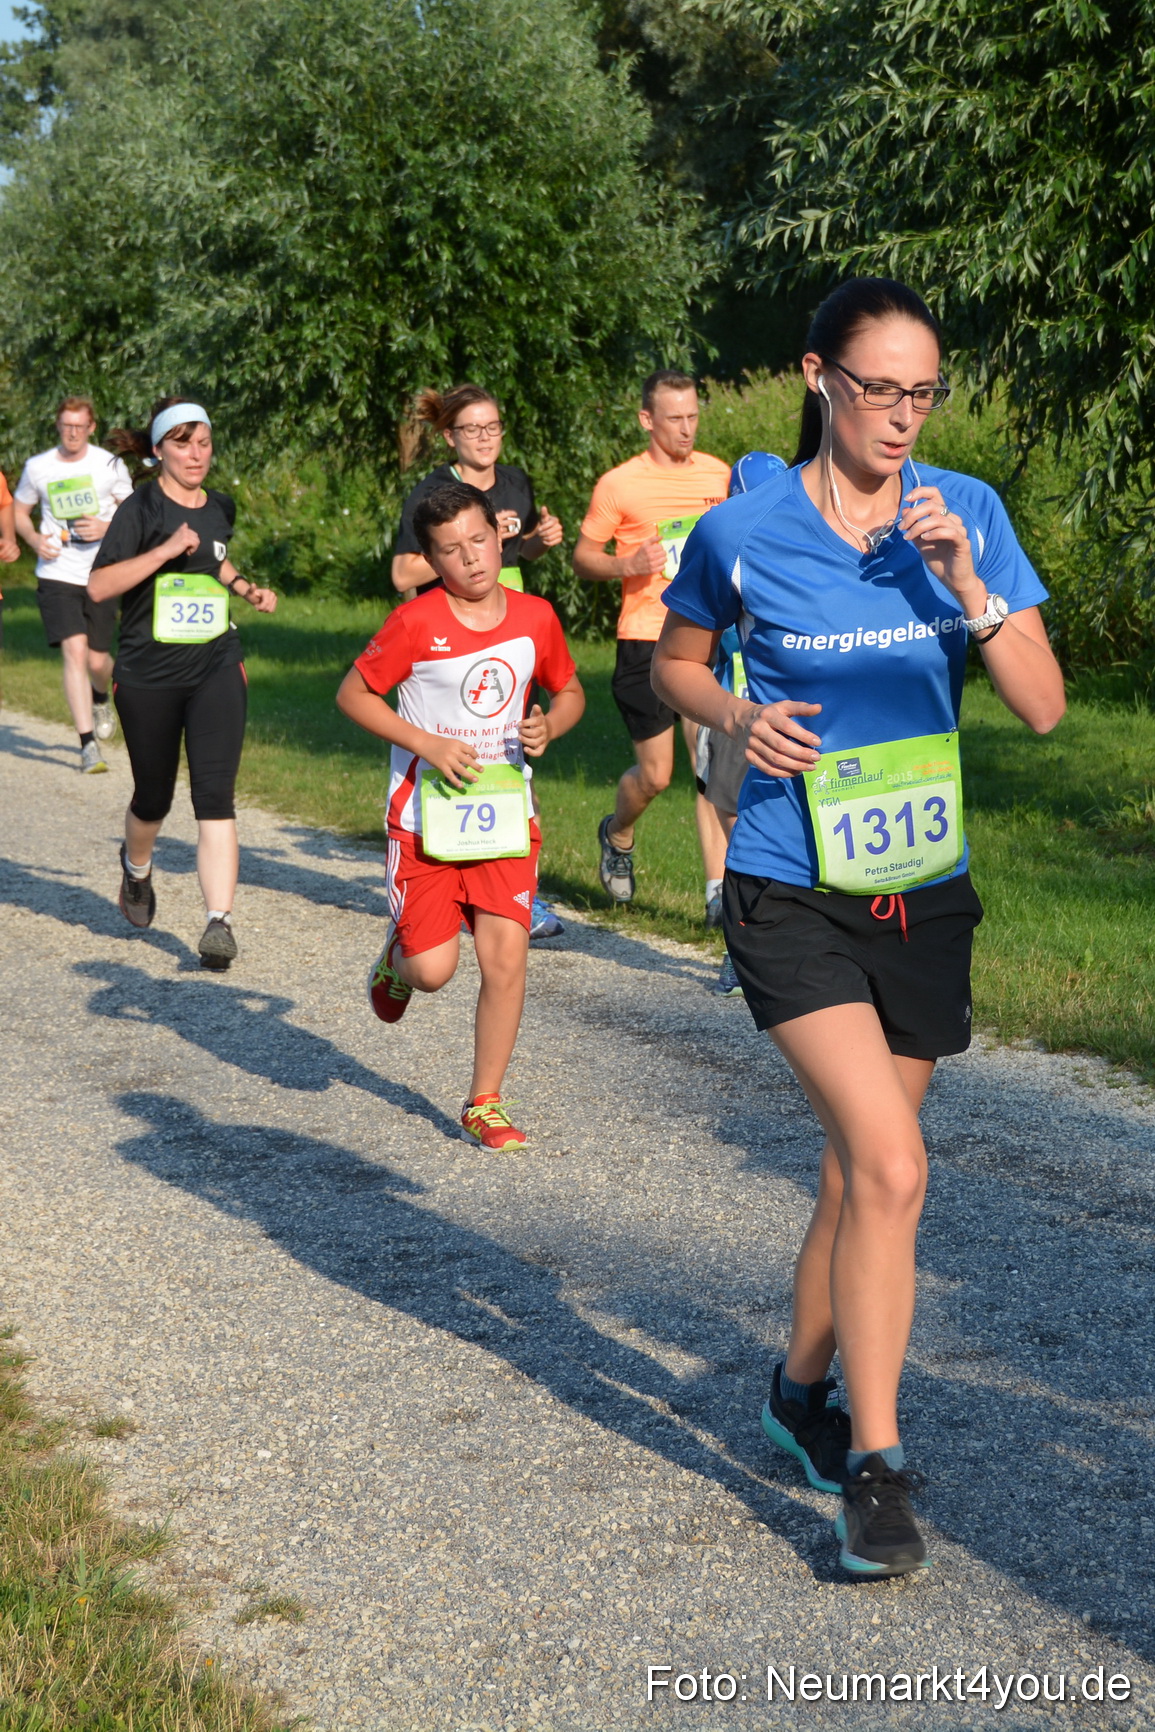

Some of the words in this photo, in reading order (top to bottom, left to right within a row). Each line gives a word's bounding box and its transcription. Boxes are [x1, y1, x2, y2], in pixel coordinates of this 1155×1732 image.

[57, 492, 93, 509] 1166
[171, 602, 215, 624] 325
[481, 727, 499, 737] MIT
[829, 769, 884, 789] firmenlauf
[887, 770, 913, 785] 2015
[455, 803, 496, 833] 79
[833, 796, 949, 860] 1313
[865, 867, 888, 876] Petra
[889, 857, 924, 872] Staudigl
